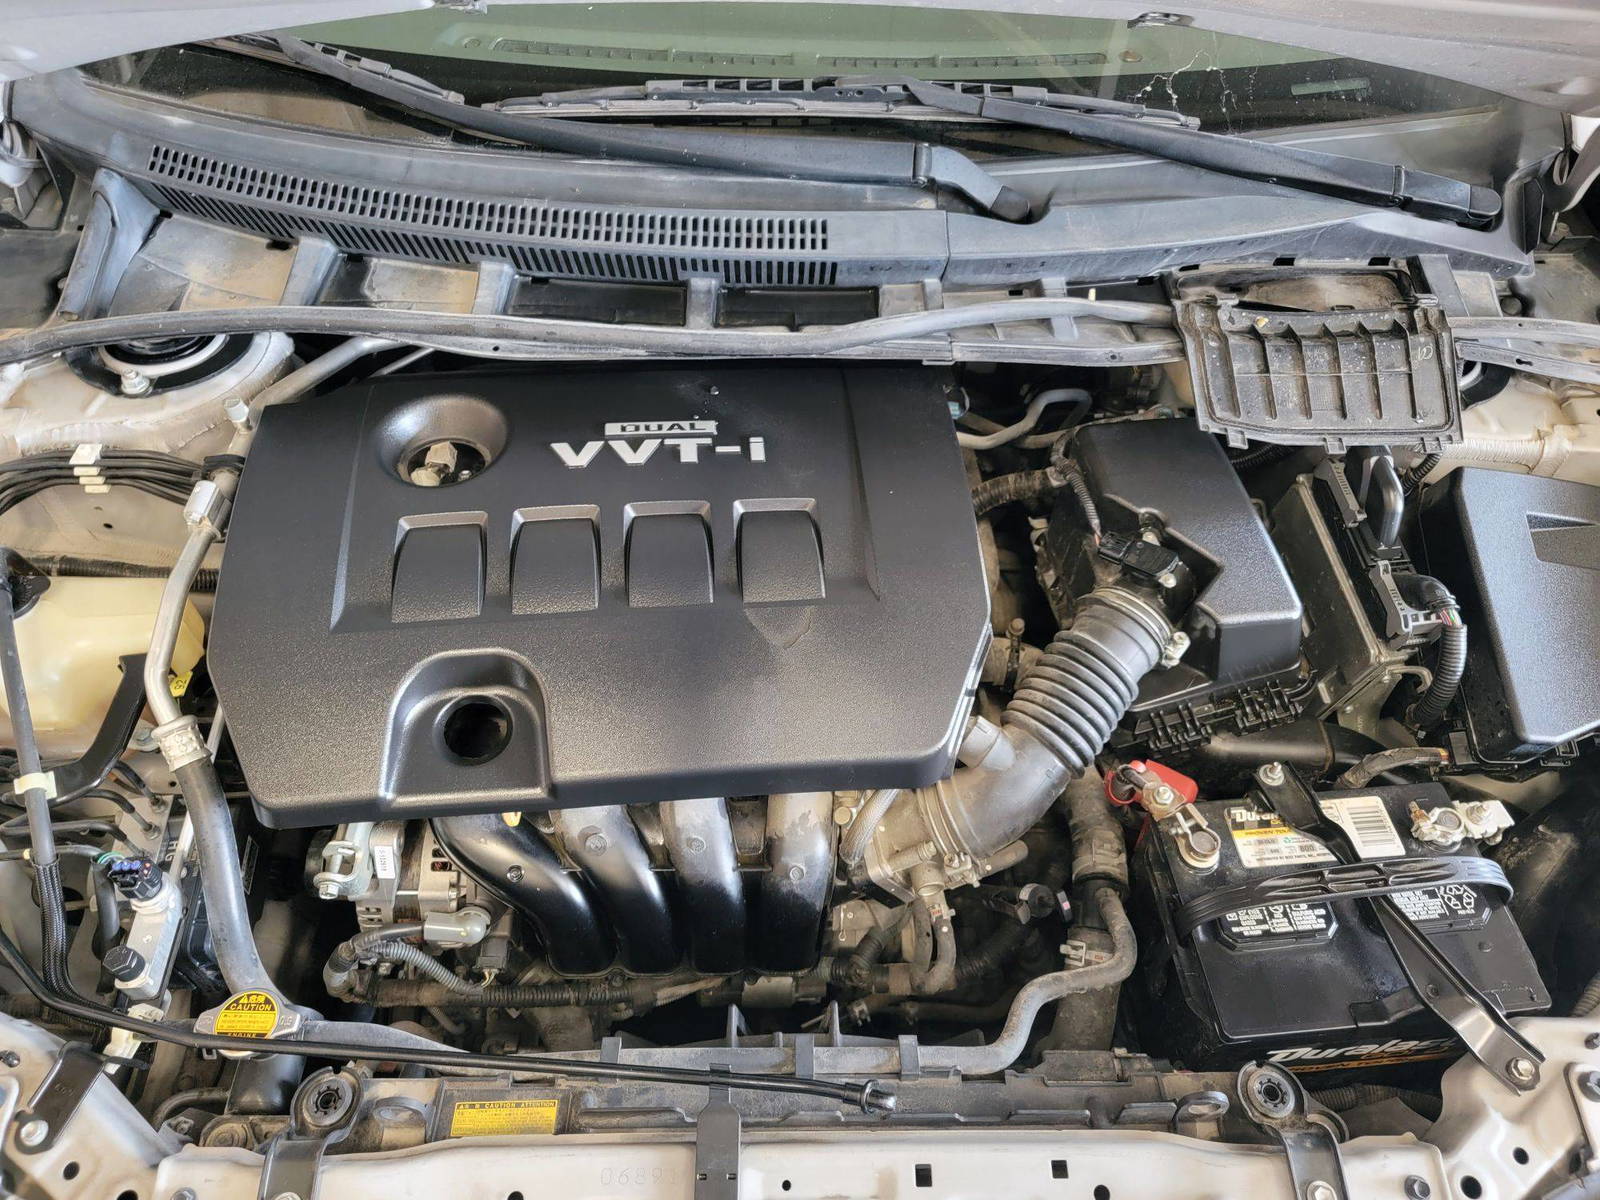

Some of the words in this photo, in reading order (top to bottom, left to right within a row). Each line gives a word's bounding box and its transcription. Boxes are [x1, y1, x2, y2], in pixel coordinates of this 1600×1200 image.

[618, 421, 709, 433] DUAL
[550, 436, 766, 469] VVT-i
[229, 1003, 272, 1012] CAUTION
[484, 1102, 516, 1110] CAUTION
